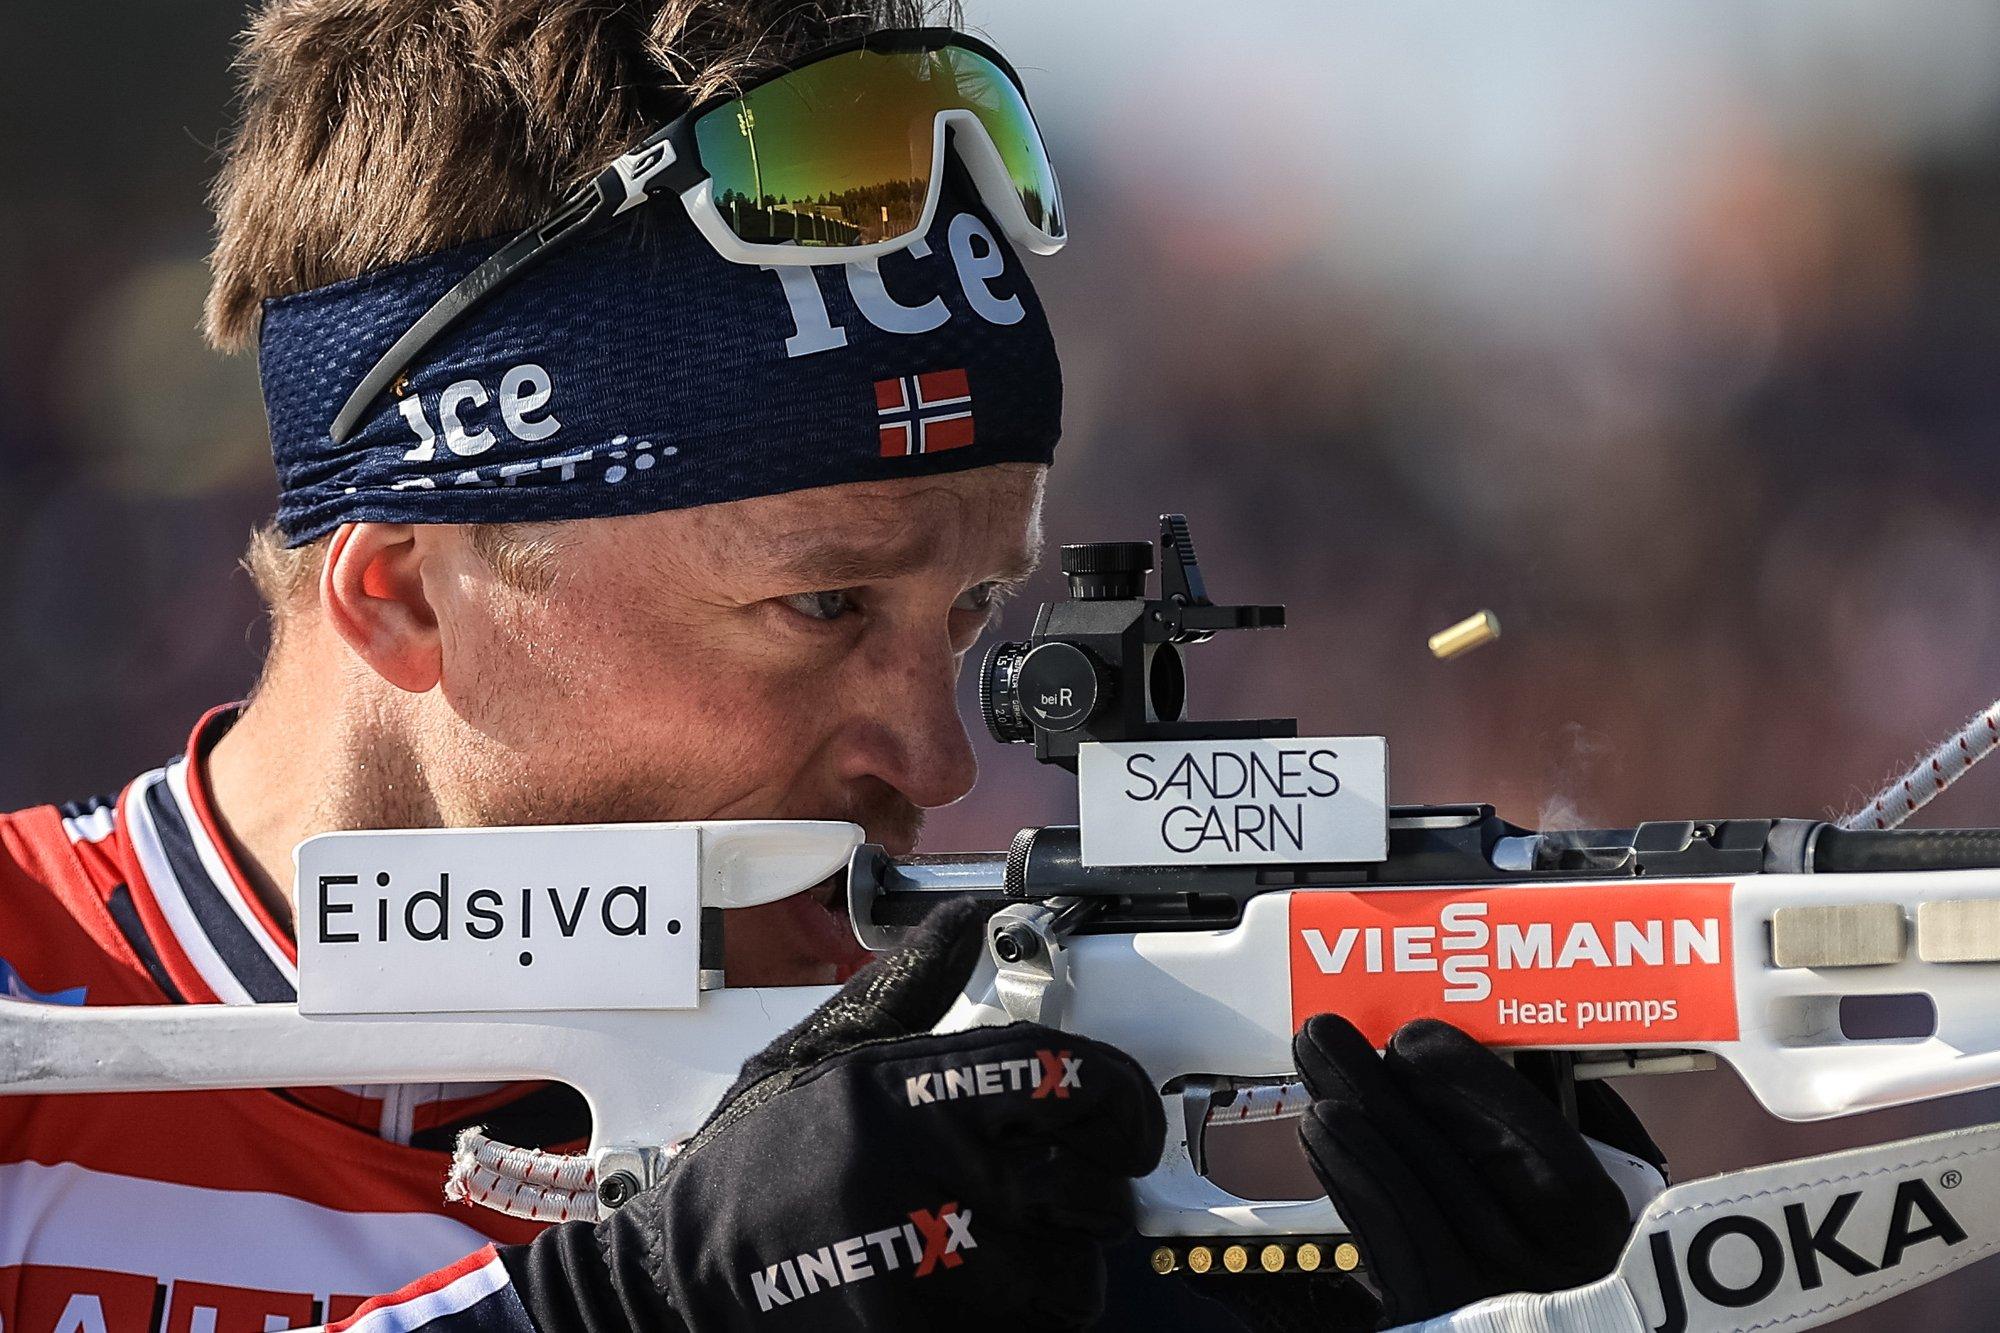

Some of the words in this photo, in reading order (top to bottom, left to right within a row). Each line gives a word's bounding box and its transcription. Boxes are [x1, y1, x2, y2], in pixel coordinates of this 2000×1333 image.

[1124, 749, 1340, 802] SANDNES
[1161, 803, 1304, 853] GARN
[318, 871, 682, 967] Eidsiva.
[1301, 902, 1721, 1002] VIESSMANN
[1498, 998, 1568, 1025] Heat
[1577, 999, 1678, 1029] pumps
[905, 1050, 1083, 1107] KINETIXX
[750, 1201, 979, 1312] KINETIXX
